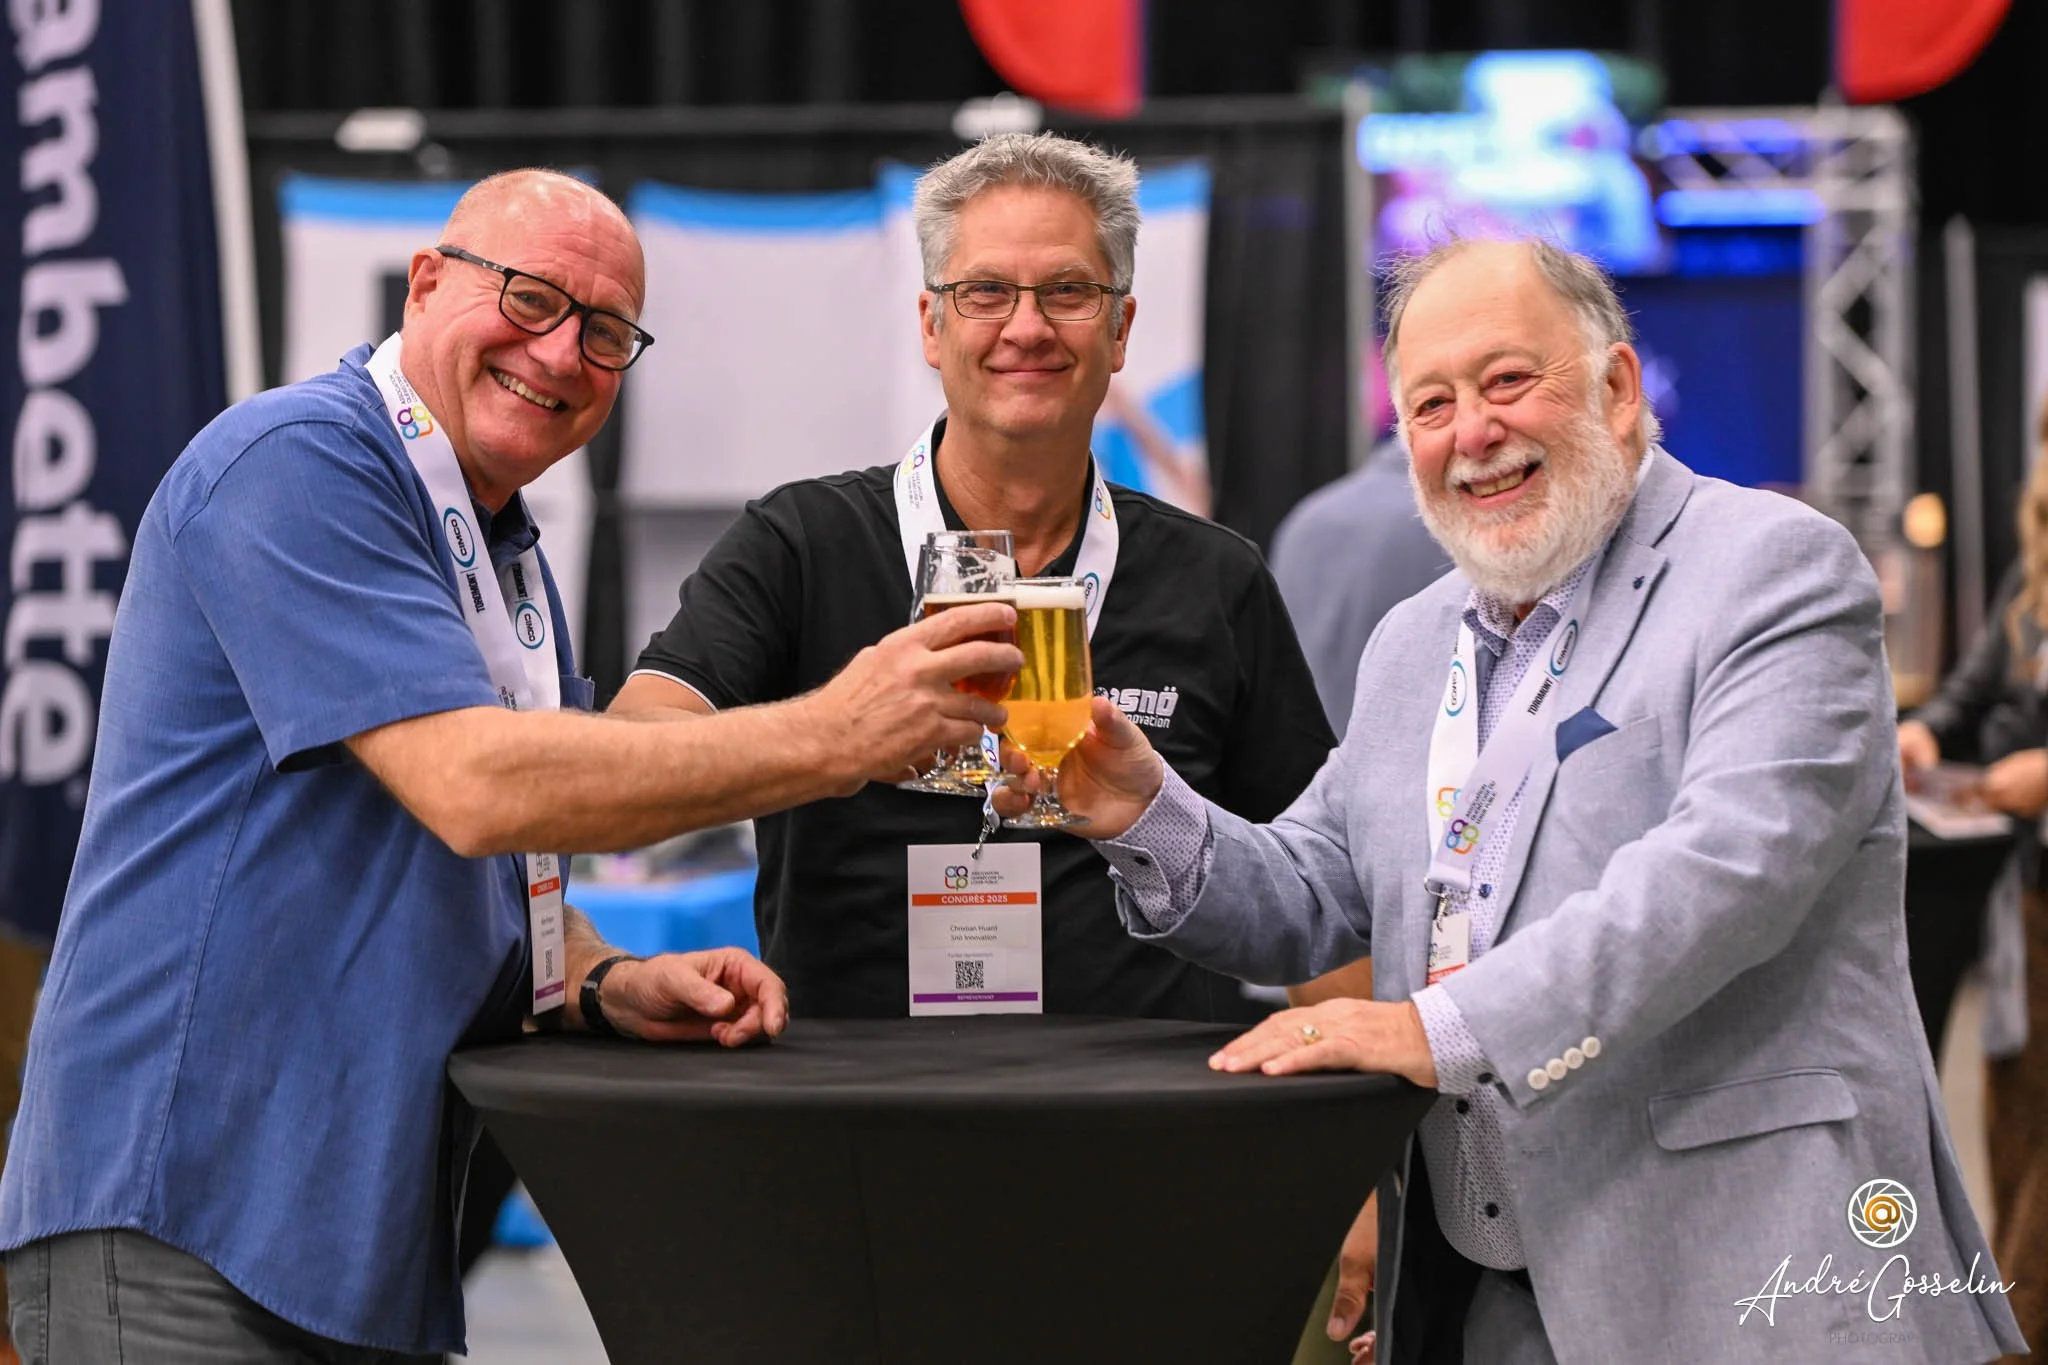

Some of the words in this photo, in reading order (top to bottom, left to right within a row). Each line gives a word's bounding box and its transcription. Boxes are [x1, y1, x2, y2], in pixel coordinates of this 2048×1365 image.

[451, 518, 468, 557] CIMCO
[466, 572, 486, 614] TOROMONT
[523, 612, 536, 642] CIMCO
[1527, 677, 1554, 716] TOROMONT
[941, 894, 985, 904] CONGRÈS
[987, 895, 1008, 904] 2025
